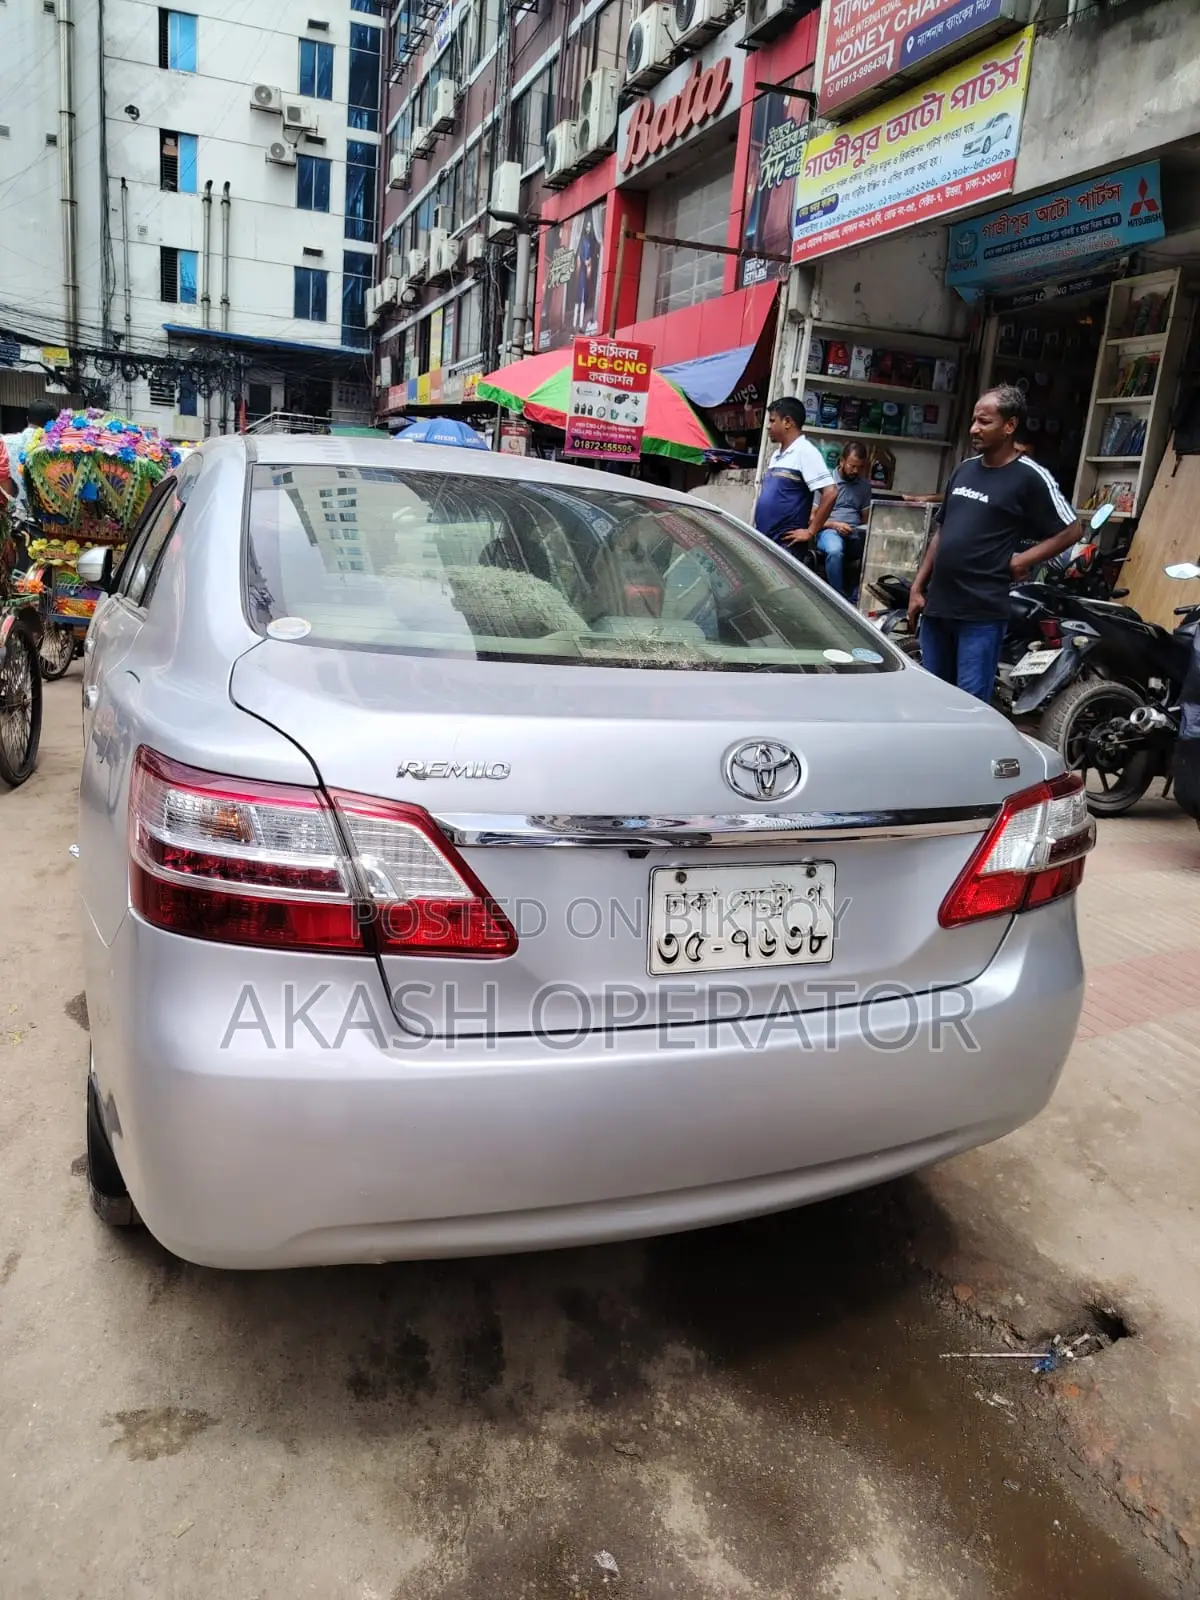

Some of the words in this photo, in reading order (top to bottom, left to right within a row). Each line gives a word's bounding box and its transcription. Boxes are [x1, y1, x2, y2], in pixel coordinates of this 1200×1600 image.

[828, 19, 890, 75] MONEY
[621, 57, 733, 176] Bata
[804, 126, 882, 178] গাজীপুর
[886, 93, 946, 143] অটো
[1034, 196, 1073, 222] অটো
[577, 354, 648, 375] LPG-CNG
[656, 925, 828, 965] ৩৫-৭৬৩৮
